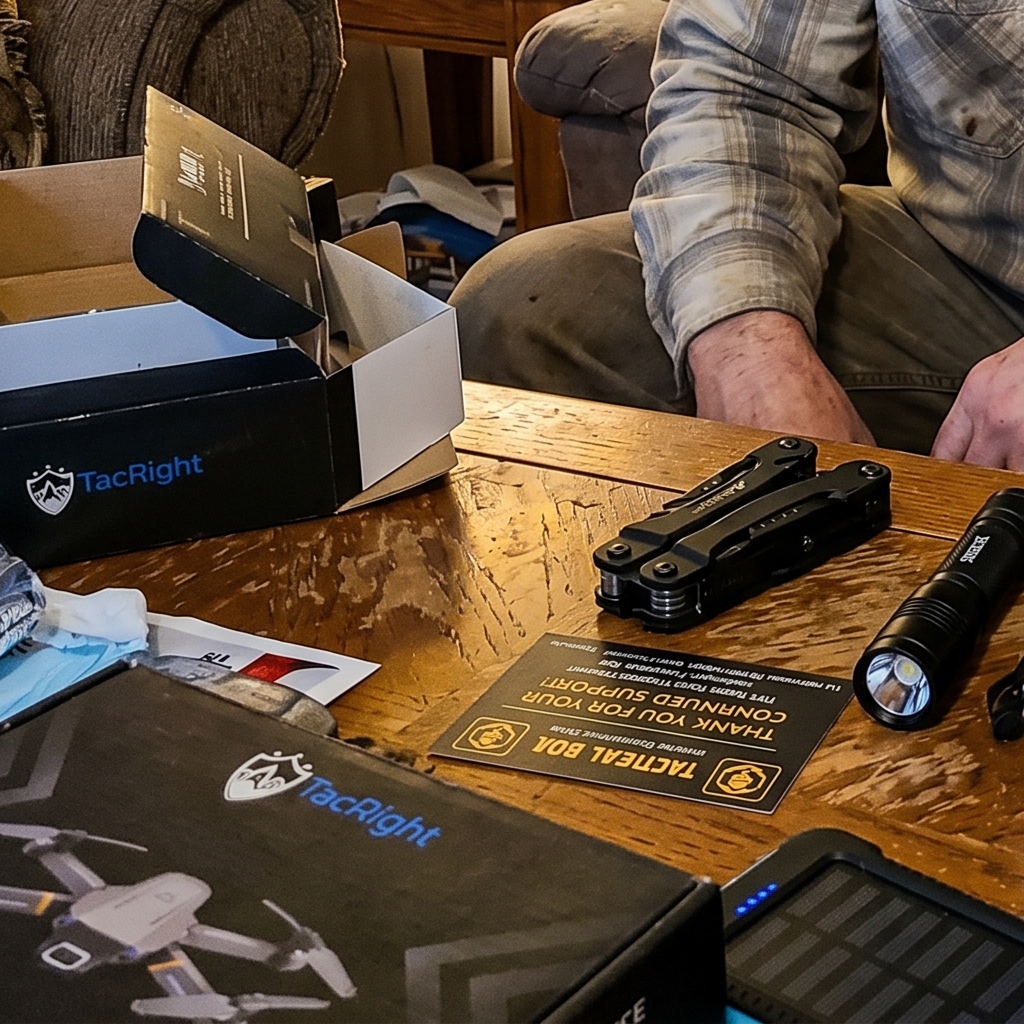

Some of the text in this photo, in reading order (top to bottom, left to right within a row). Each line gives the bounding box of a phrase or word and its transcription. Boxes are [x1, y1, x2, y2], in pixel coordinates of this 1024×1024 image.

[76, 454, 204, 493] TacRight
[521, 690, 582, 712] YOUR
[542, 676, 648, 704] SUPPORT!
[587, 700, 631, 719] FOR
[638, 707, 685, 726] YOU
[692, 717, 775, 742] THANK
[300, 776, 442, 848] TacRight
